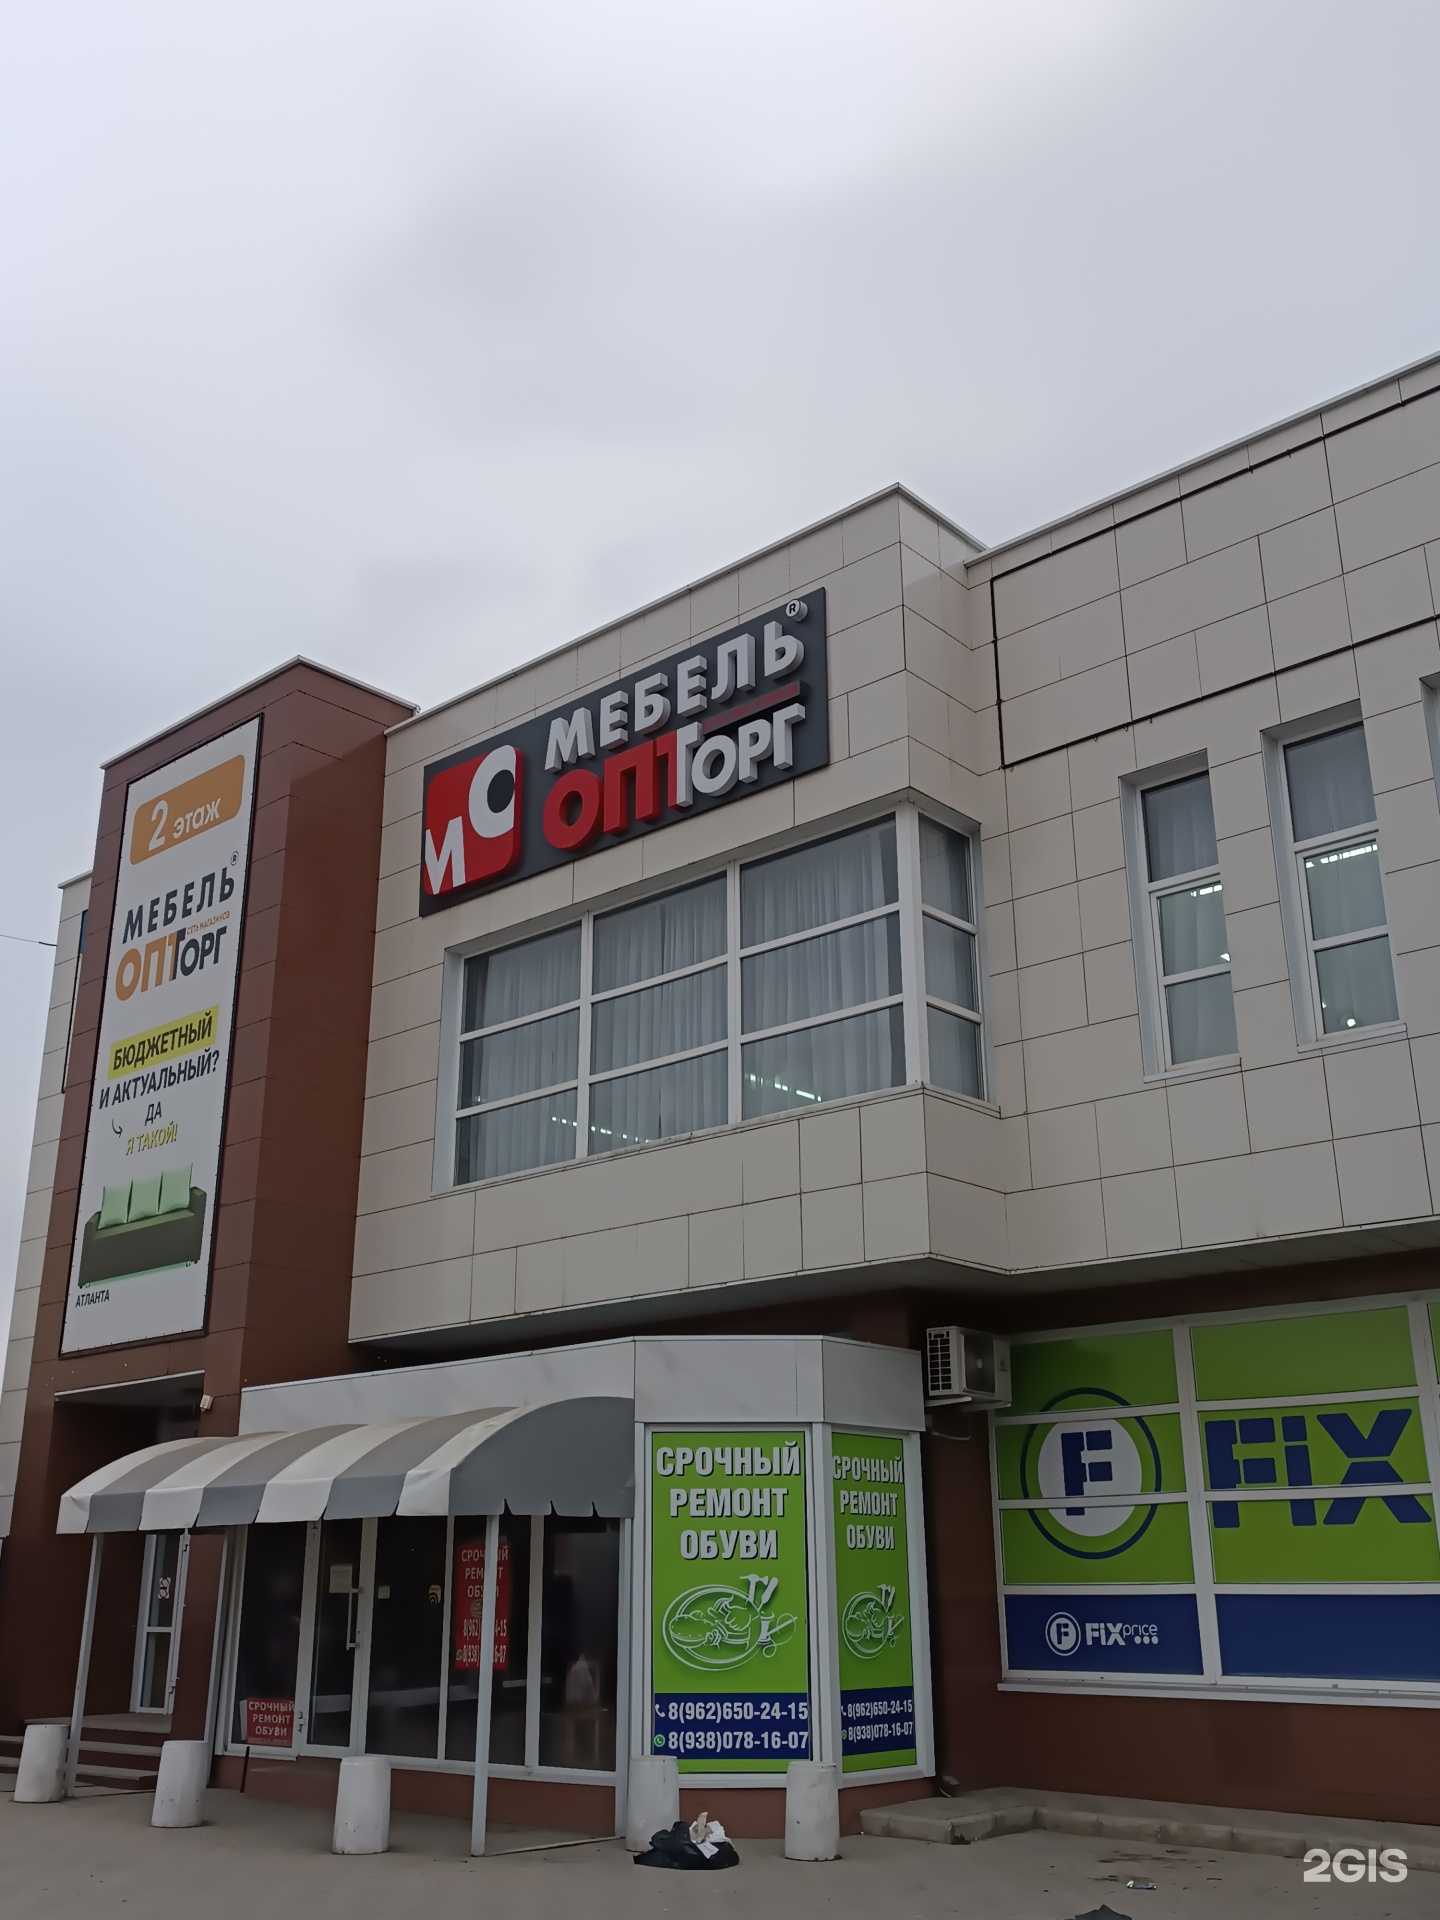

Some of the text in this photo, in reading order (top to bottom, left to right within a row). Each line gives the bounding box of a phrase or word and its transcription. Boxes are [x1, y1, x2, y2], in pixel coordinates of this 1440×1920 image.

[545, 621, 805, 774] МЕБЕЛЬ
[148, 797, 222, 851] 2 этаж
[122, 866, 235, 944] МЕБЕЛЬ
[112, 1012, 213, 1071] БЮДЖЕТНЫЙ
[98, 1050, 220, 1109] И АКТУАЛЬНЫЙ?
[144, 1100, 163, 1127] ДА
[126, 1121, 178, 1156] Я ТАКОЙ!
[75, 1290, 110, 1308] АТЛАНТА
[656, 1441, 801, 1477] СРОЧНЫЙ
[832, 1456, 904, 1485] СРОЧНЫЙ
[1060, 1430, 1113, 1517] F
[670, 1488, 788, 1518] РЕМОНТ
[839, 1490, 898, 1517] РЕМОНТ
[680, 1529, 778, 1560] ОБУВИ
[846, 1524, 896, 1550] ОБУВИ
[248, 1700, 295, 1712] СРОЧНЫЙ
[252, 1714, 290, 1724] РЕМОНТ
[668, 1702, 808, 1722] 8(962)650-24-15
[255, 1725, 288, 1737] ОБУВИ
[668, 1731, 809, 1751] 8(938)078-16-07
[848, 1722, 913, 1743] 8(938)078-16-07
